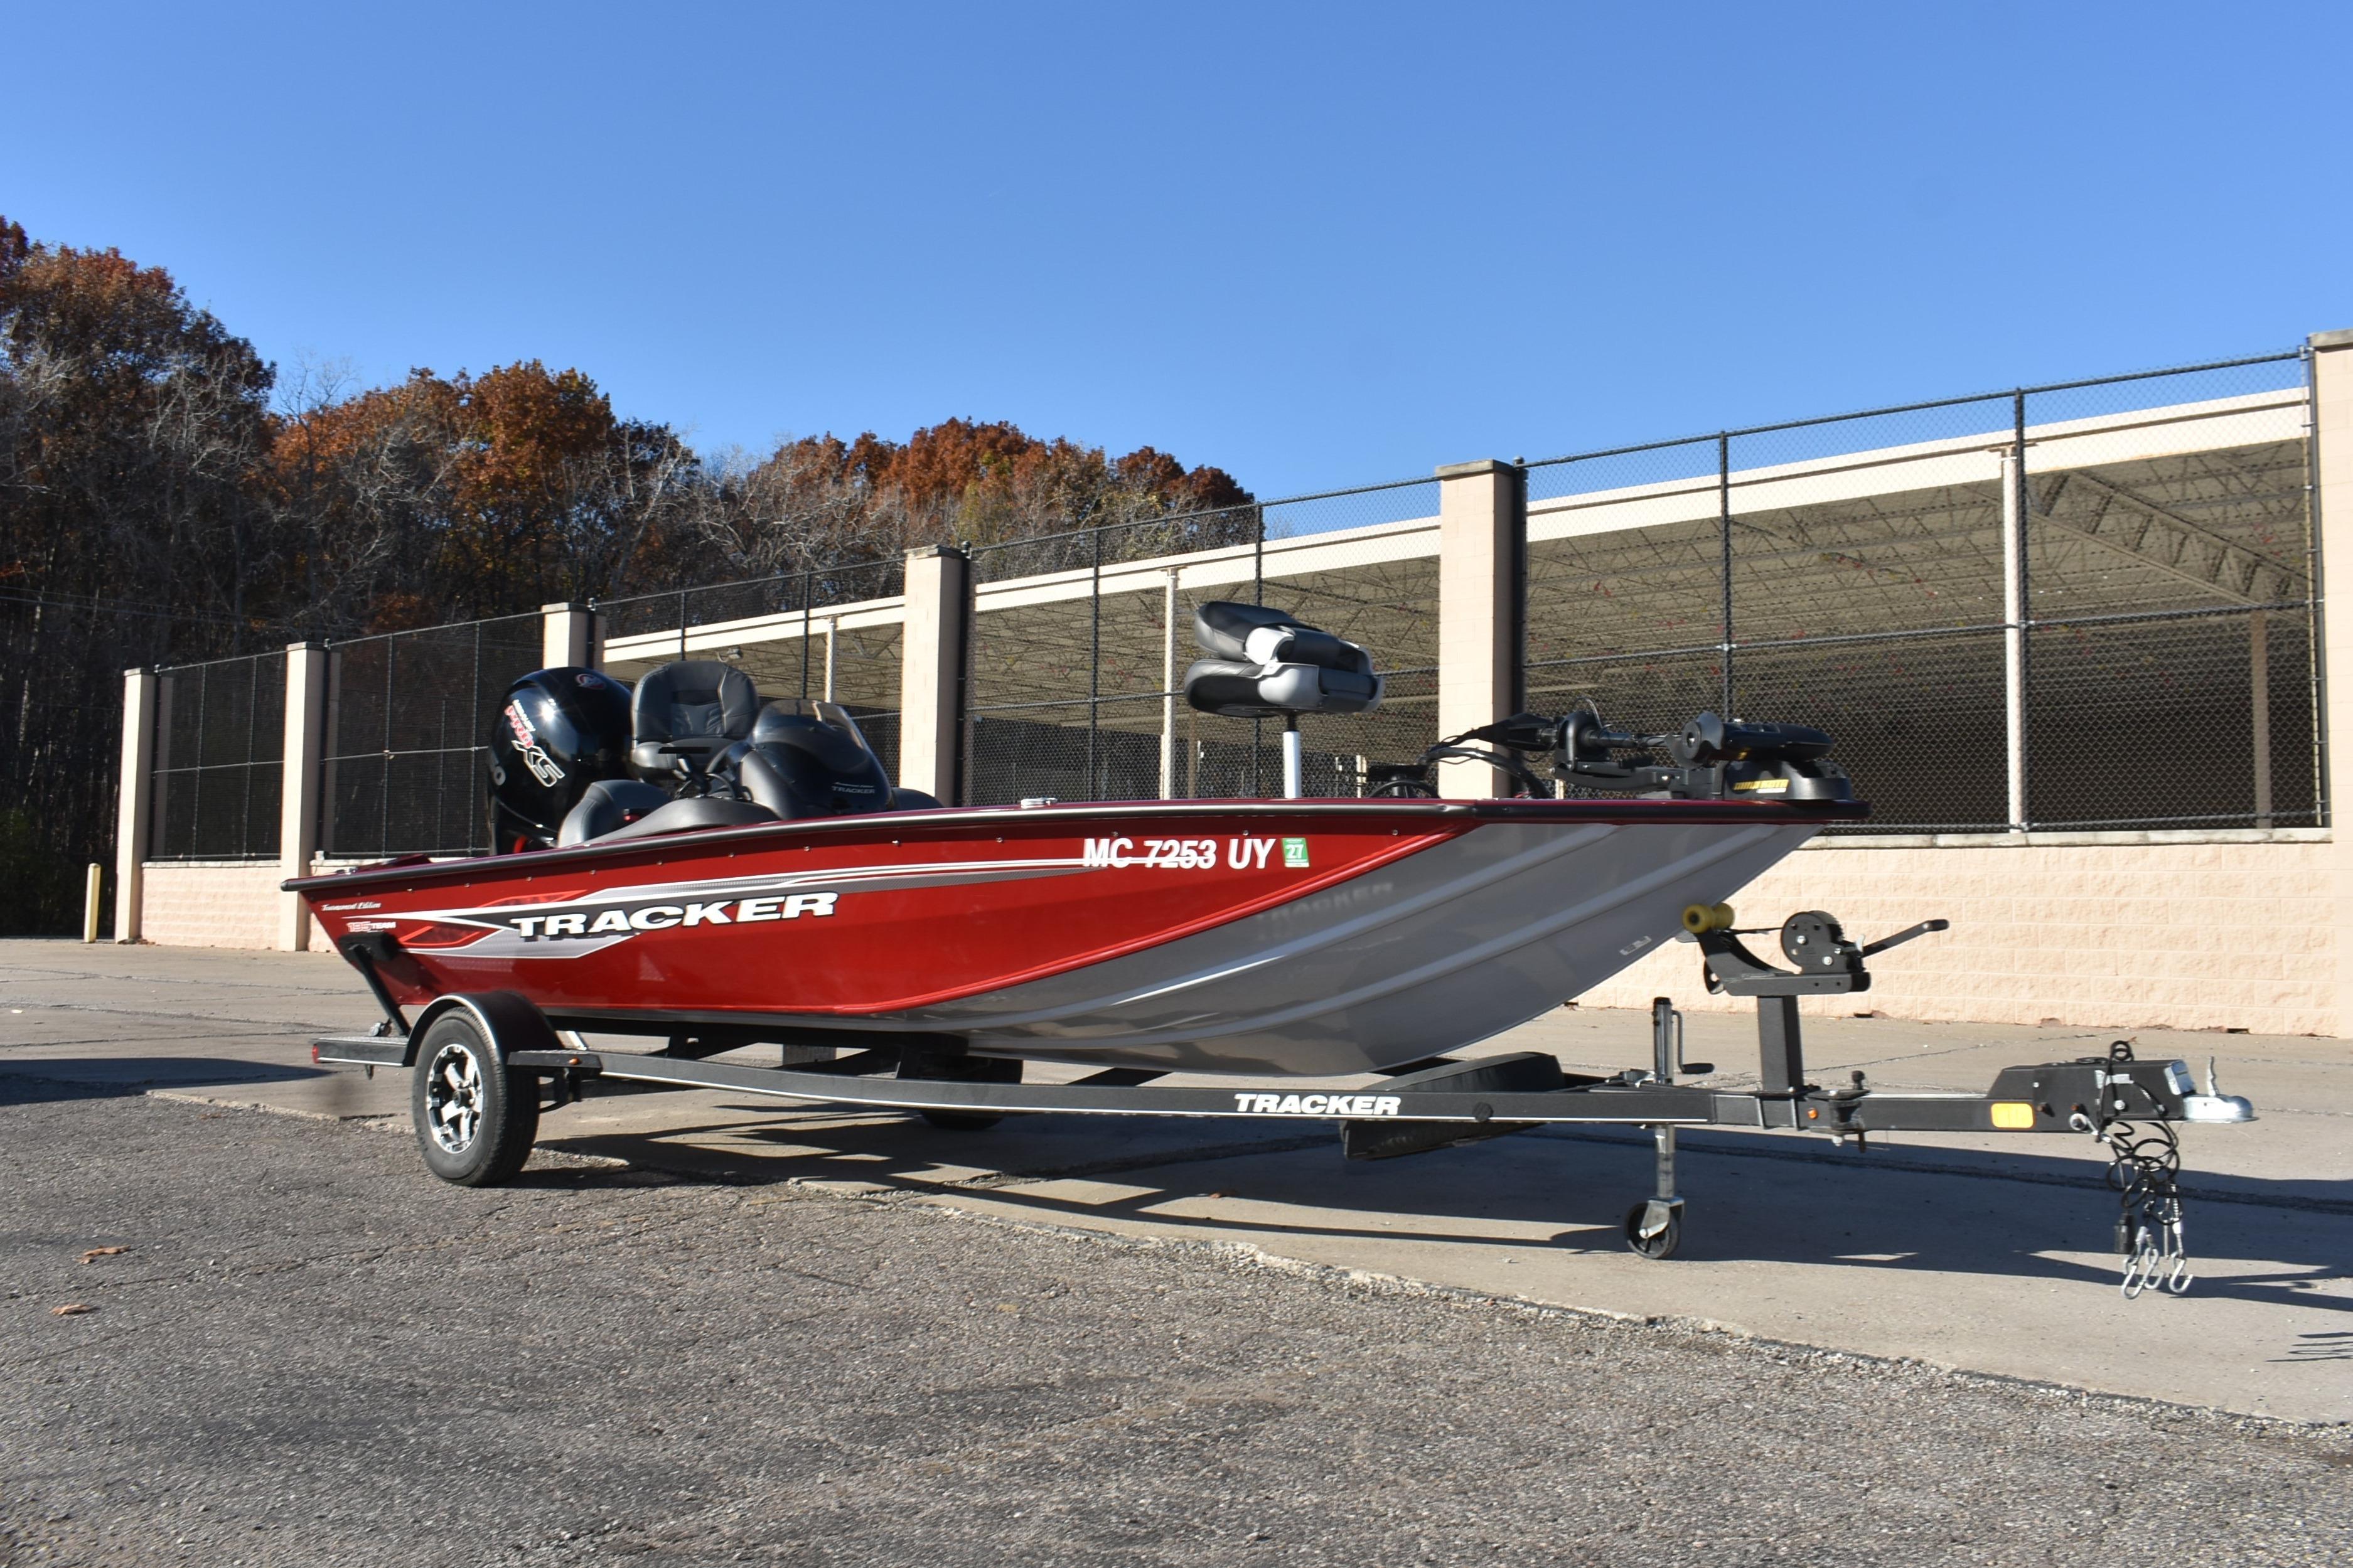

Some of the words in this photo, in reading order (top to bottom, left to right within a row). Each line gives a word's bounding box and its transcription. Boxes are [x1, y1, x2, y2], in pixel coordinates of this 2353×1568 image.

[832, 786, 876, 794] TRACKER
[1083, 838, 1133, 868] MC
[1144, 840, 1217, 869] 7253
[1228, 838, 1277, 869] UY
[1285, 844, 1304, 859] 27
[510, 892, 839, 937] TRACKER
[1234, 1093, 1402, 1116] TRACKER
